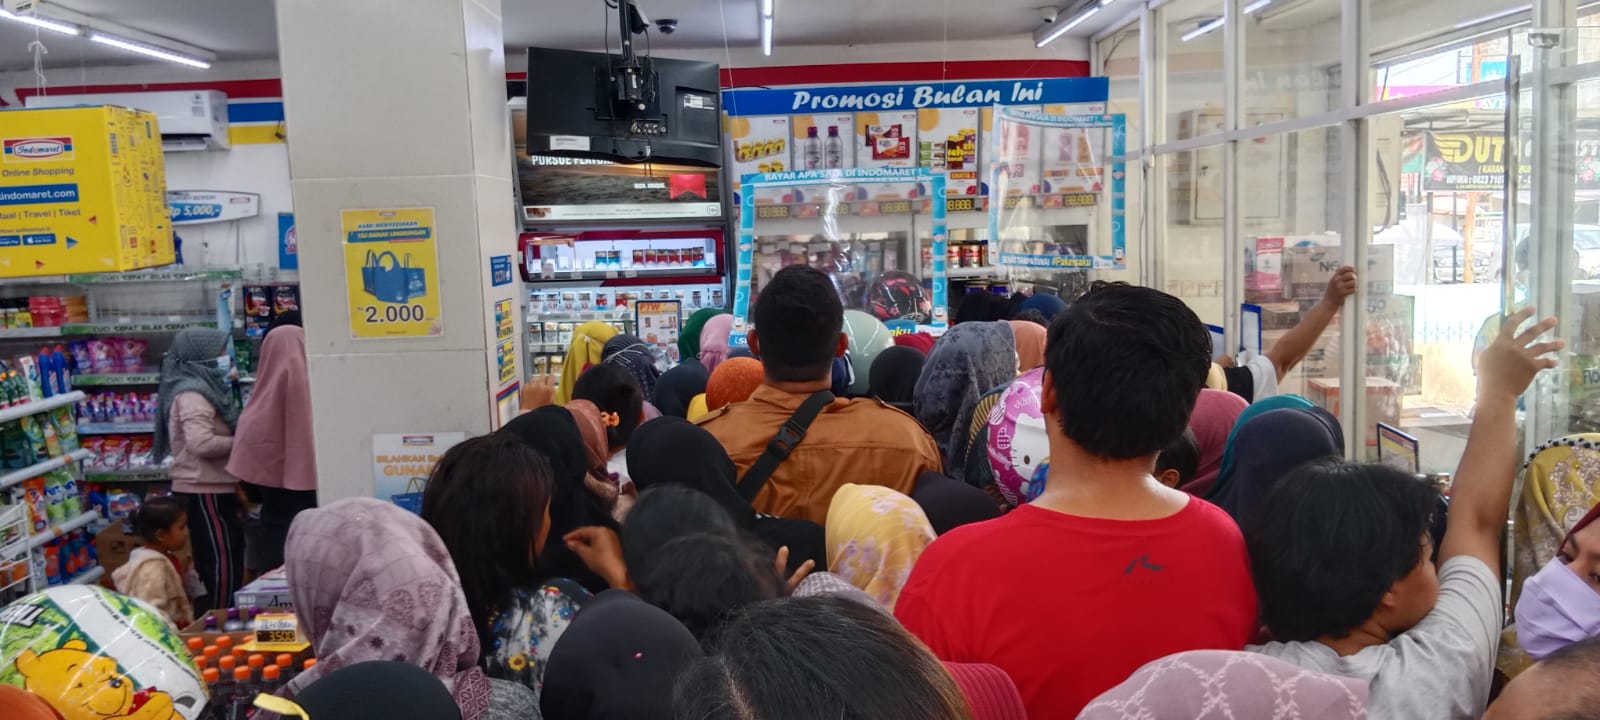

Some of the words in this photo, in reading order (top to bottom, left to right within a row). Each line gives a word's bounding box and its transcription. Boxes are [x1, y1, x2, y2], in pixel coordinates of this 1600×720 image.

[792, 88, 904, 110] Promosi
[913, 85, 1001, 107] Bulan
[1012, 82, 1043, 102] Ini
[17, 146, 60, 154] Indomaret
[1434, 134, 1506, 163] DUT
[531, 155, 572, 166] PURSUE
[2, 169, 30, 177] Online
[32, 168, 74, 176] Shopping
[765, 171, 796, 180] BAYAR
[799, 170, 818, 179] APA
[845, 168, 856, 177] DI
[858, 168, 915, 177] INDOMARET
[0, 190, 75, 200] indomaret.com
[24, 209, 51, 217] Travel
[59, 208, 81, 216] Tiket
[365, 304, 425, 323] 2.000
[268, 594, 293, 607] Am
